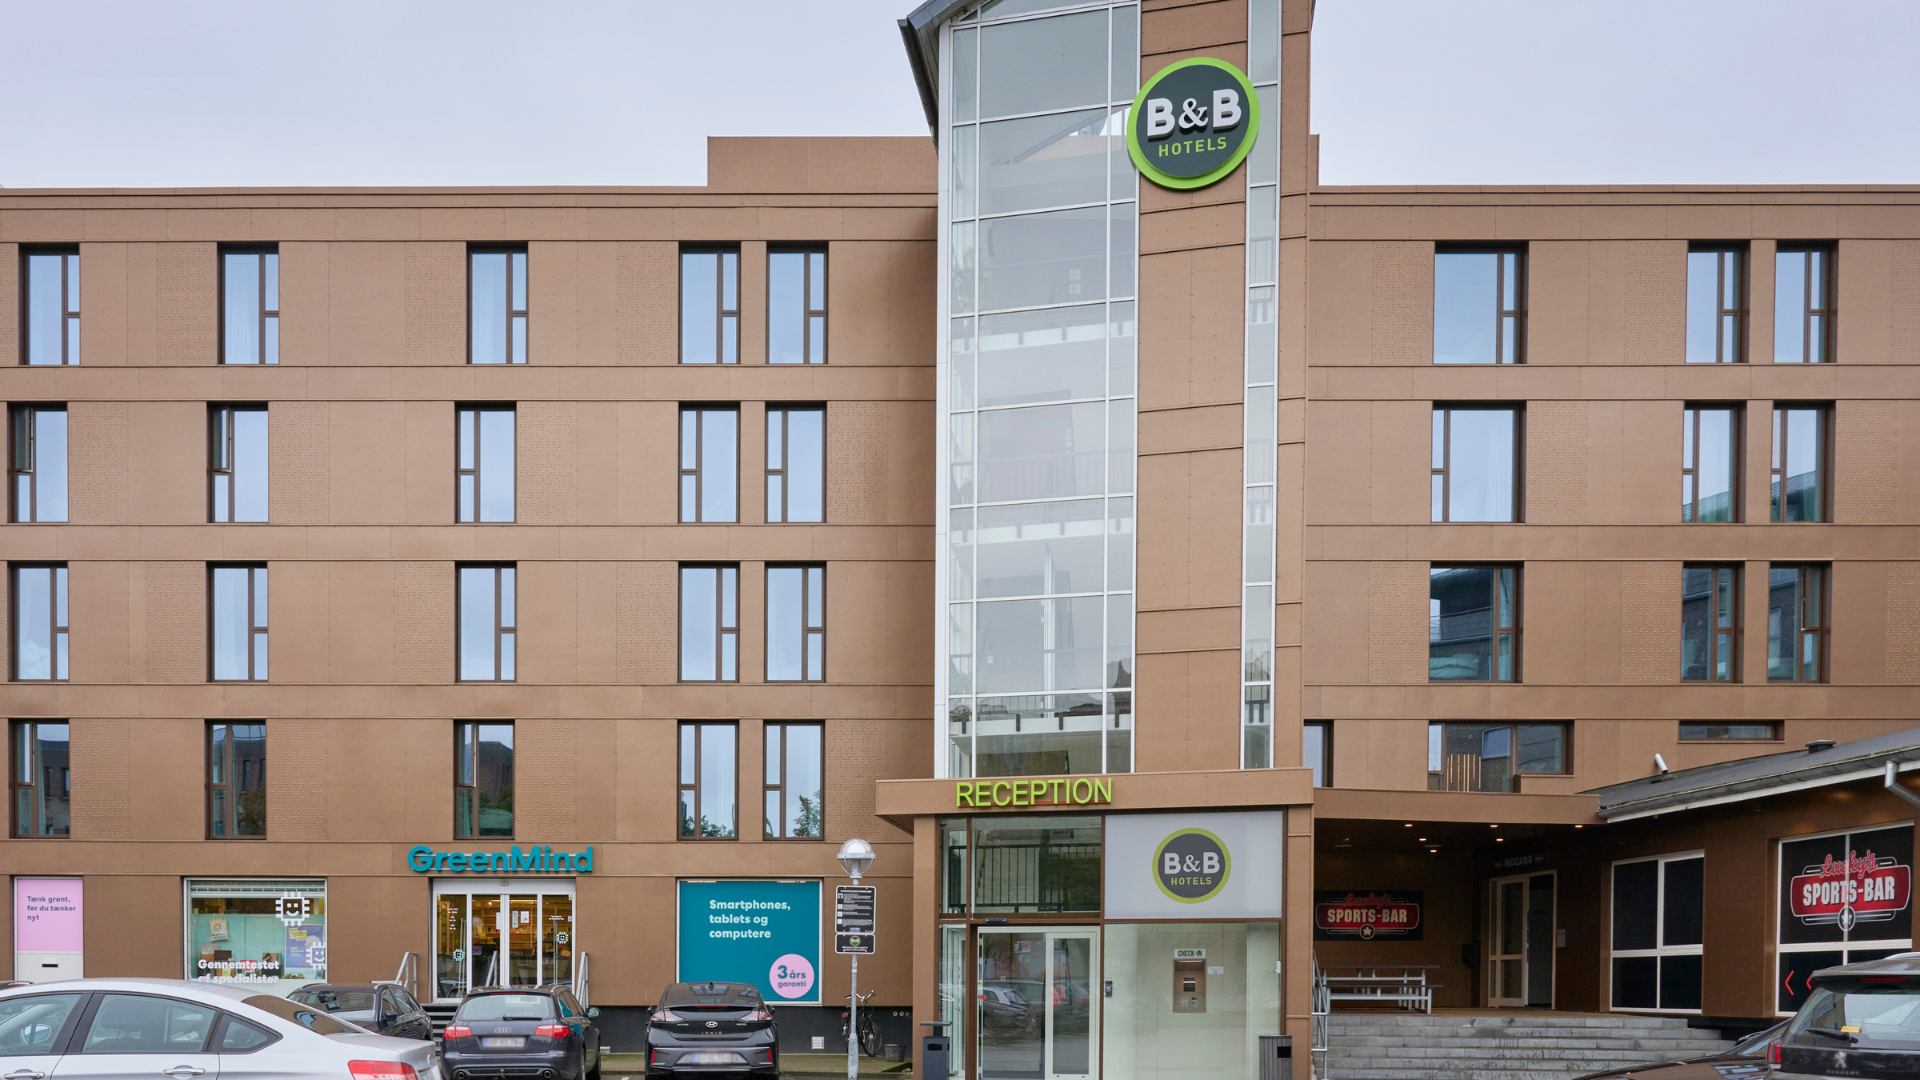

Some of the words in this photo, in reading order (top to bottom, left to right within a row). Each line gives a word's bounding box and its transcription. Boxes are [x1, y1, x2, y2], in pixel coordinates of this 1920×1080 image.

[1147, 88, 1242, 139] B&B
[1158, 136, 1227, 157] HOTELS
[956, 777, 1112, 807] RECEPTION
[407, 845, 593, 872] GreenMind
[1164, 851, 1220, 875] B&B
[1818, 849, 1878, 879] Lucky's
[1170, 876, 1212, 886] HOTELS
[1802, 876, 1896, 907] SPORTS-BAR
[709, 899, 791, 911] Smartphones,
[1342, 892, 1394, 909] Lucky's
[709, 914, 751, 924] tablets
[753, 916, 768, 926] og
[1327, 909, 1408, 923] SPORTS-BAR
[709, 929, 771, 940] computere
[197, 959, 280, 970] Gennemtestet
[213, 973, 280, 984] specialister
[777, 965, 788, 979] 3
[789, 969, 806, 979] års
[777, 981, 807, 989] garanti
